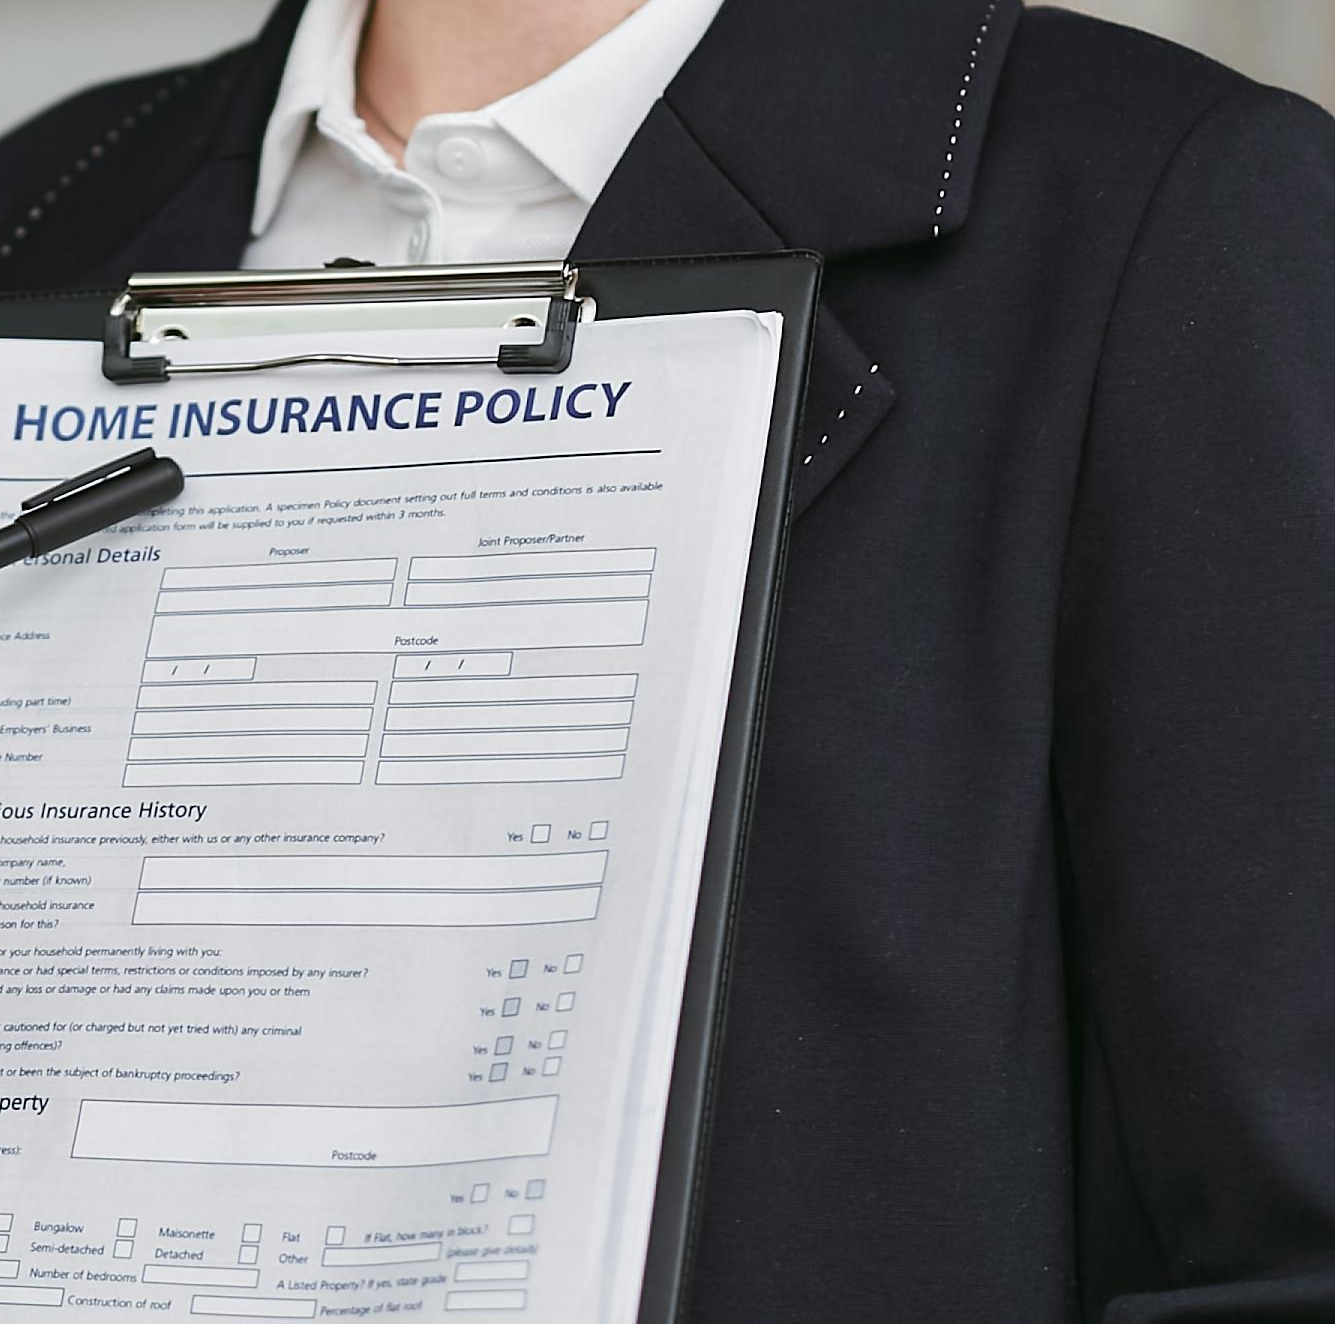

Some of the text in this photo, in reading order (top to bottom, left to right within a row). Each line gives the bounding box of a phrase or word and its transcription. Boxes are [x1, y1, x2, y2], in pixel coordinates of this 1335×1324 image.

[13, 381, 633, 442] HOME INSURANCE POLICY
[188, 506, 205, 516] this
[265, 502, 273, 511] A
[276, 502, 321, 513] specimen
[323, 499, 352, 510] Policy
[353, 495, 402, 508] document
[404, 494, 438, 505] setting
[439, 492, 458, 502] out
[460, 490, 477, 501] full
[479, 490, 507, 499] terms
[508, 487, 530, 498] and
[531, 485, 583, 497] conditions
[585, 486, 594, 494] is
[596, 483, 618, 494] also
[619, 480, 664, 493] available
[477, 533, 585, 548] Joint Proposer/Partner
[96, 545, 161, 564] Details
[268, 547, 311, 557] Proposer
[393, 635, 439, 646] Postcode
[40, 802, 132, 820] Insurance
[138, 800, 208, 823] History
[0, 834, 50, 845] household
[50, 835, 98, 845] insurance
[151, 833, 181, 844] either
[181, 833, 204, 844] with
[206, 835, 219, 844] us
[220, 835, 233, 844] or
[233, 835, 253, 846] any
[253, 832, 281, 843] other
[283, 832, 331, 843] insurance
[332, 832, 386, 845] company?
[506, 831, 525, 843] Yes
[566, 829, 583, 841] No
[2, 875, 41, 886] number
[42, 875, 53, 887] (if
[54, 875, 92, 886] known)
[8, 948, 32, 960] your
[33, 945, 84, 957] household
[83, 946, 146, 959] permanently
[147, 945, 174, 960] living
[175, 946, 199, 957] with
[331, 1149, 378, 1161] Postcode
[33, 1220, 85, 1235] Bungalow
[158, 1227, 216, 1240] Maisonette
[281, 1231, 301, 1243] Flat
[29, 1242, 105, 1256] Semi-detached
[154, 1247, 204, 1261] Detached
[277, 1252, 309, 1265] Other
[29, 1267, 138, 1284] Number of bedrooms
[67, 1296, 172, 1311] Construction of roof
